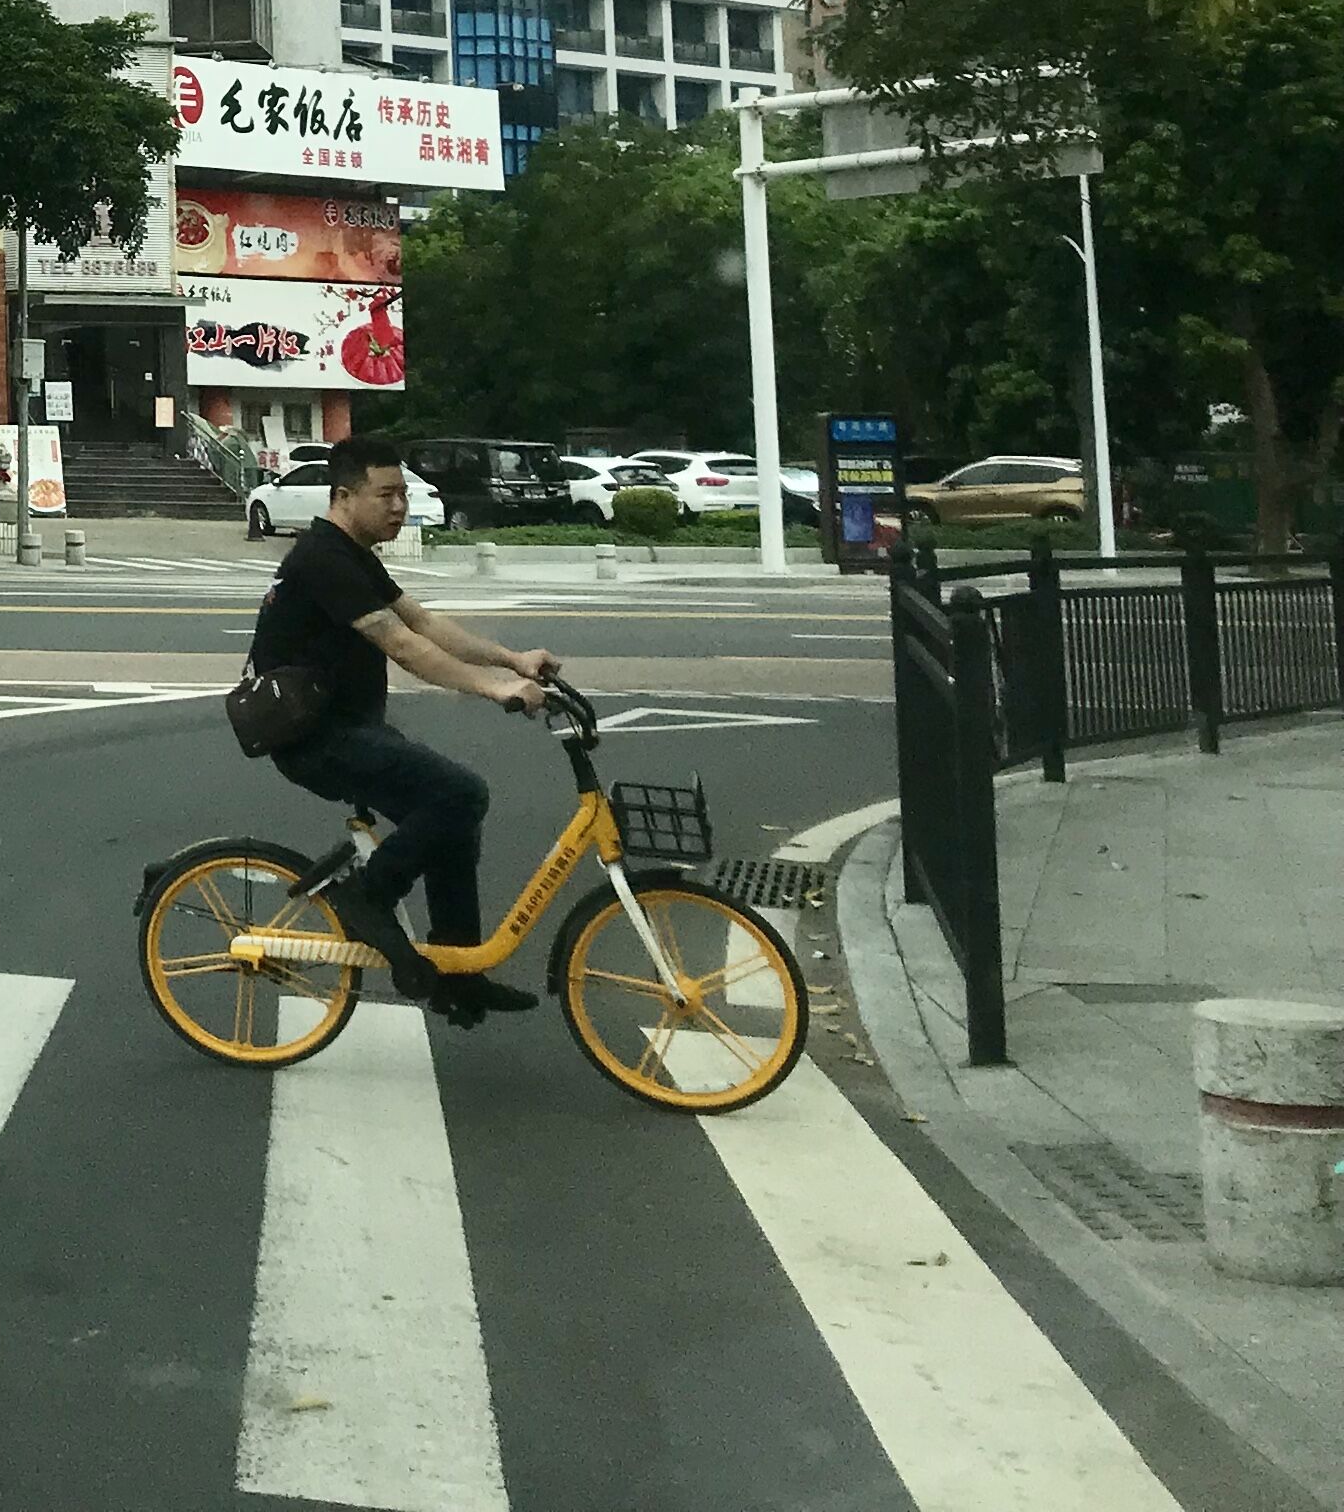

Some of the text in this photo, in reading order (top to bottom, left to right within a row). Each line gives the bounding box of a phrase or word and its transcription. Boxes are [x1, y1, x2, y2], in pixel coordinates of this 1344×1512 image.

[220, 78, 363, 143] 毛家饭店
[377, 95, 451, 129] 传承历史
[302, 146, 363, 169] 全国连锁
[419, 133, 490, 165] 品味湘肴
[38, 258, 74, 275] TEL
